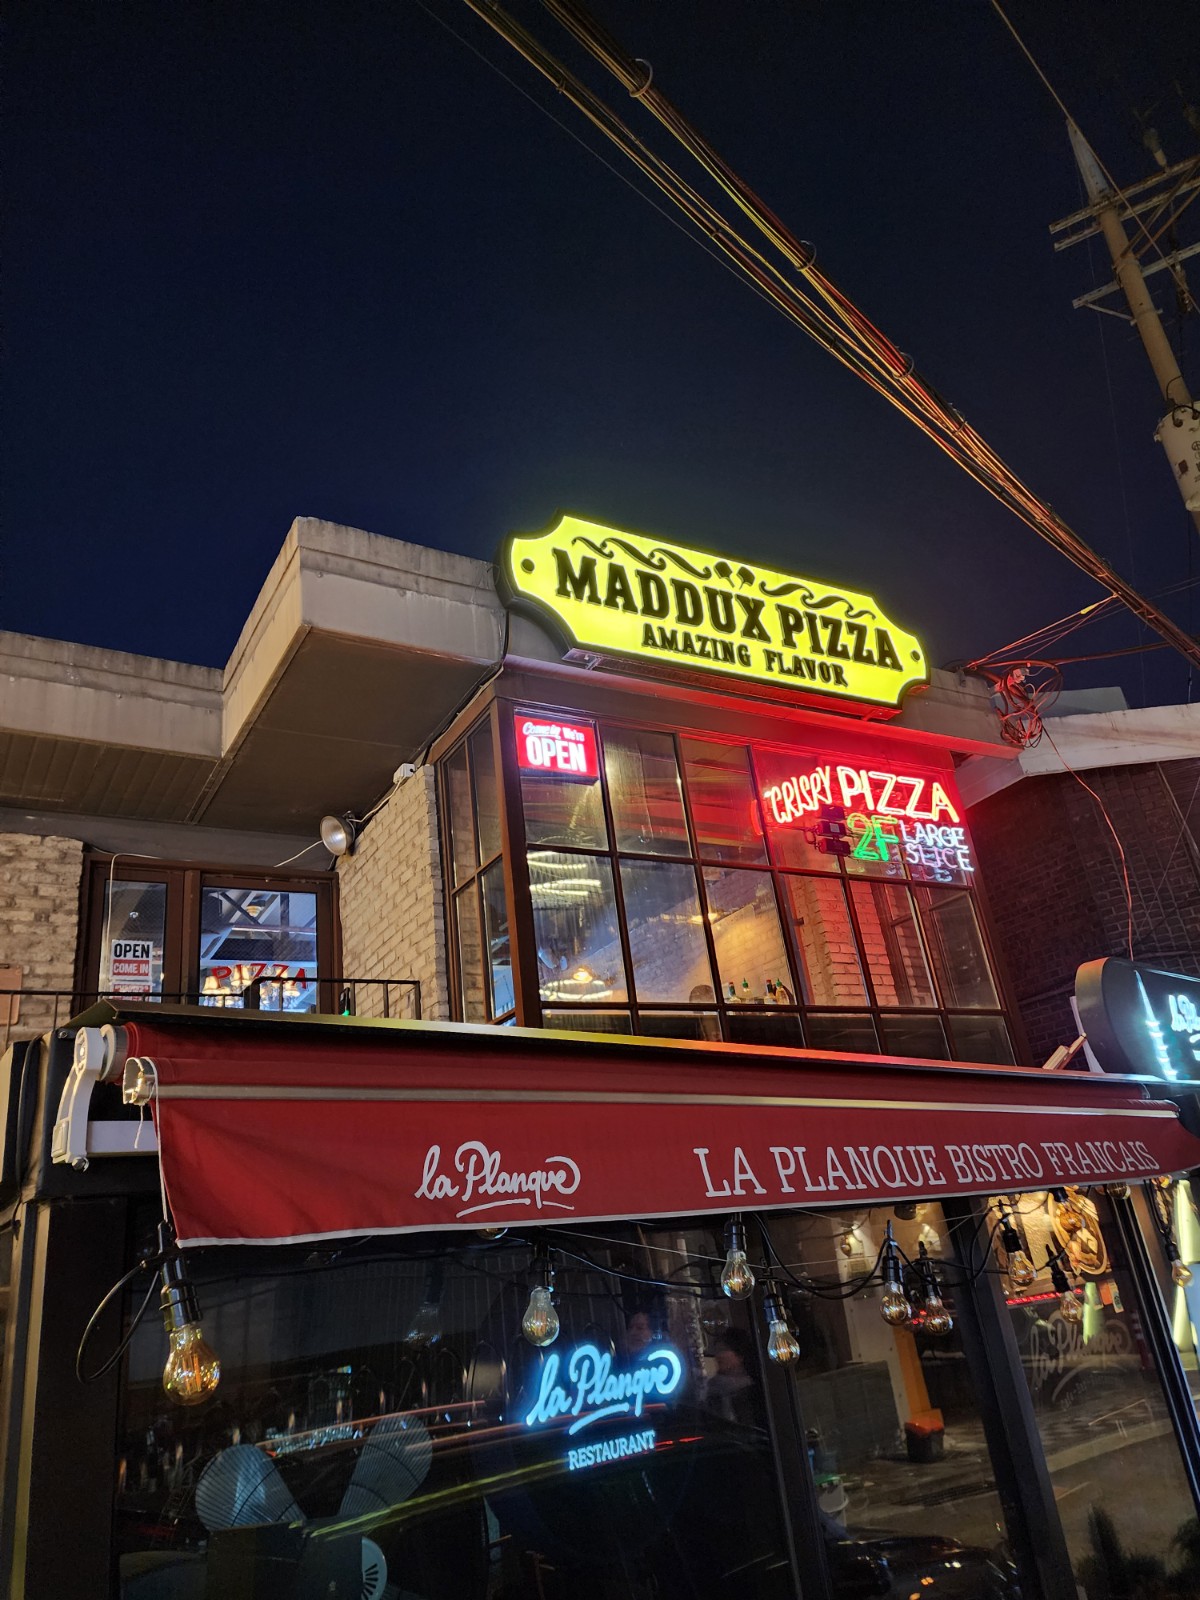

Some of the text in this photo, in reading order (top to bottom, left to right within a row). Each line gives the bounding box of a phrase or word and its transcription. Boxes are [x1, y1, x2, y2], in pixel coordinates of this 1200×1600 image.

[552, 548, 903, 672] MADDUX PIZZA
[641, 623, 849, 687] AMAZING FLAVOR
[526, 736, 587, 773] OPEN
[764, 765, 961, 824] CRISPY PIZZA
[847, 812, 899, 862] 2F
[900, 820, 969, 849] LARGE
[904, 842, 975, 871] SLICE
[113, 942, 150, 958] OPEN
[113, 962, 150, 974] COME IN
[211, 963, 308, 989] PIZZA
[414, 1140, 581, 1209] la Planque
[693, 1140, 1160, 1198] LA PLANQUE BISTRO FRANCAIS
[526, 1345, 682, 1426] la Planque
[568, 1430, 656, 1471] RESTAURANT
